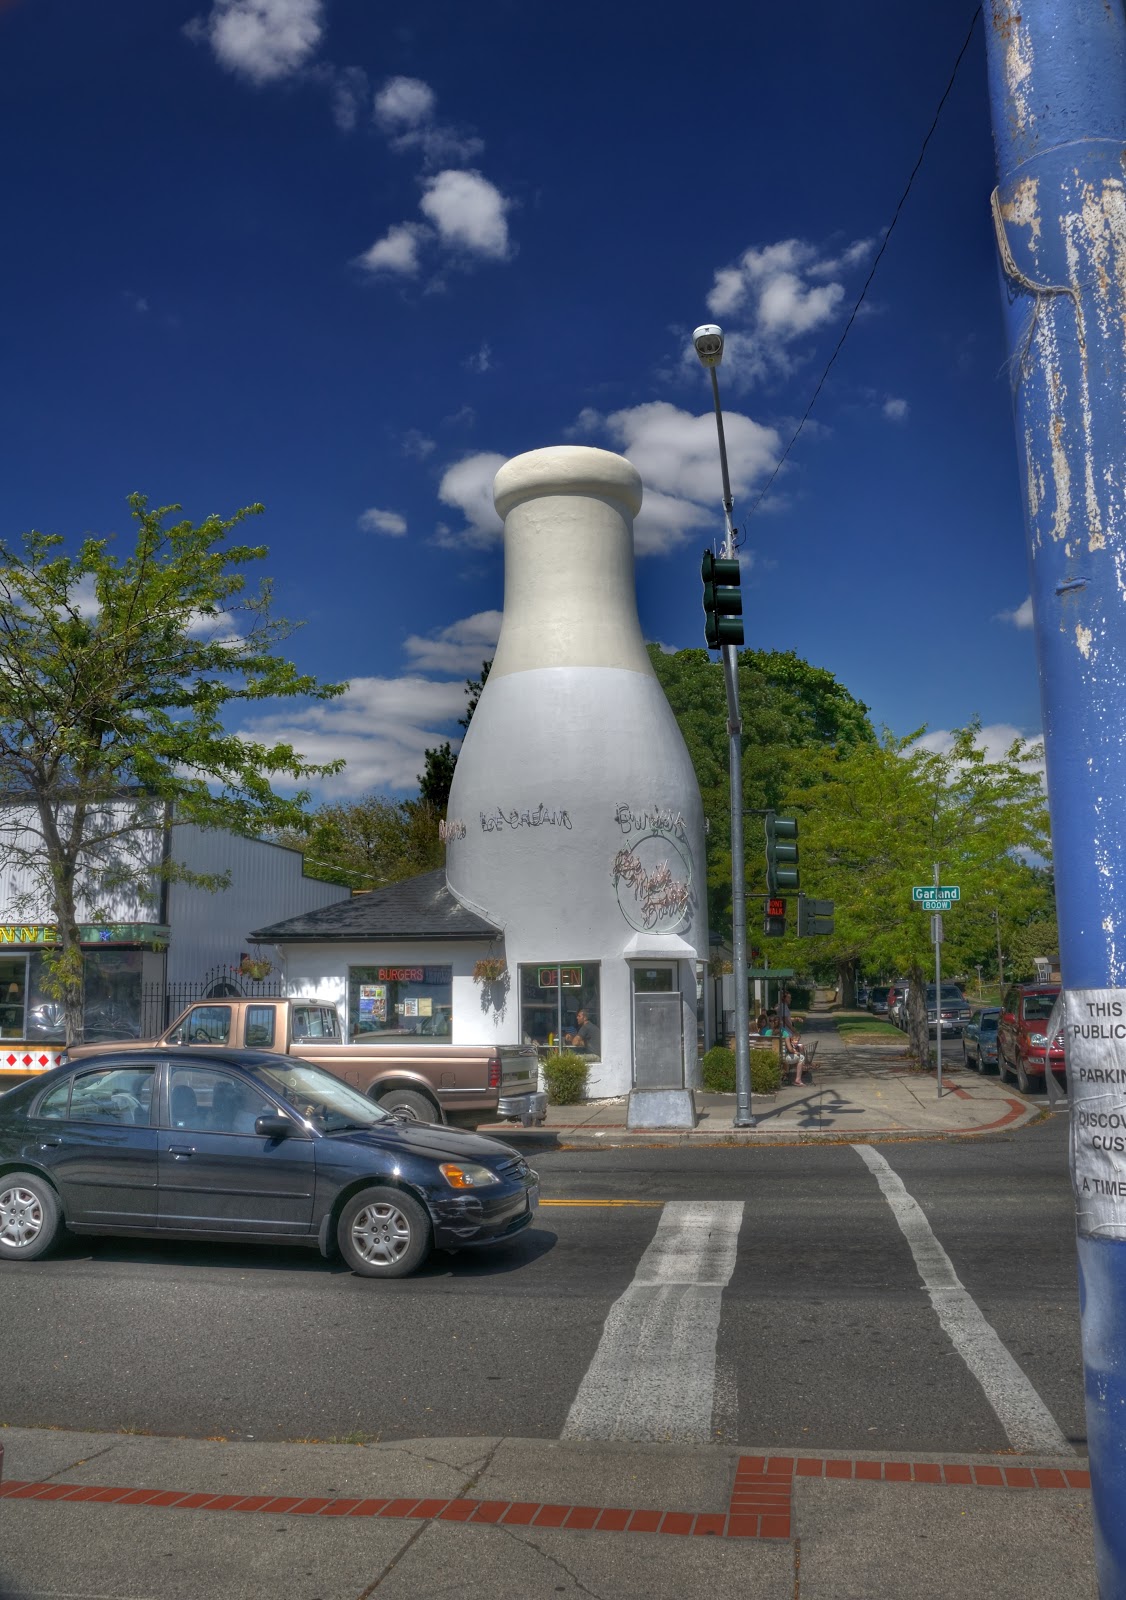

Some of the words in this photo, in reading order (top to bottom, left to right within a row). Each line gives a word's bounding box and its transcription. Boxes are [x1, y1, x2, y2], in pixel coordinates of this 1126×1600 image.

[916, 888, 957, 899] Garland
[378, 967, 424, 981] BURGERS
[541, 969, 581, 986] OPEN
[1086, 1001, 1123, 1017] THIS
[1073, 1024, 1126, 1039] PUBLIC
[1092, 1135, 1126, 1151] CUS
[1082, 1177, 1090, 1192] A
